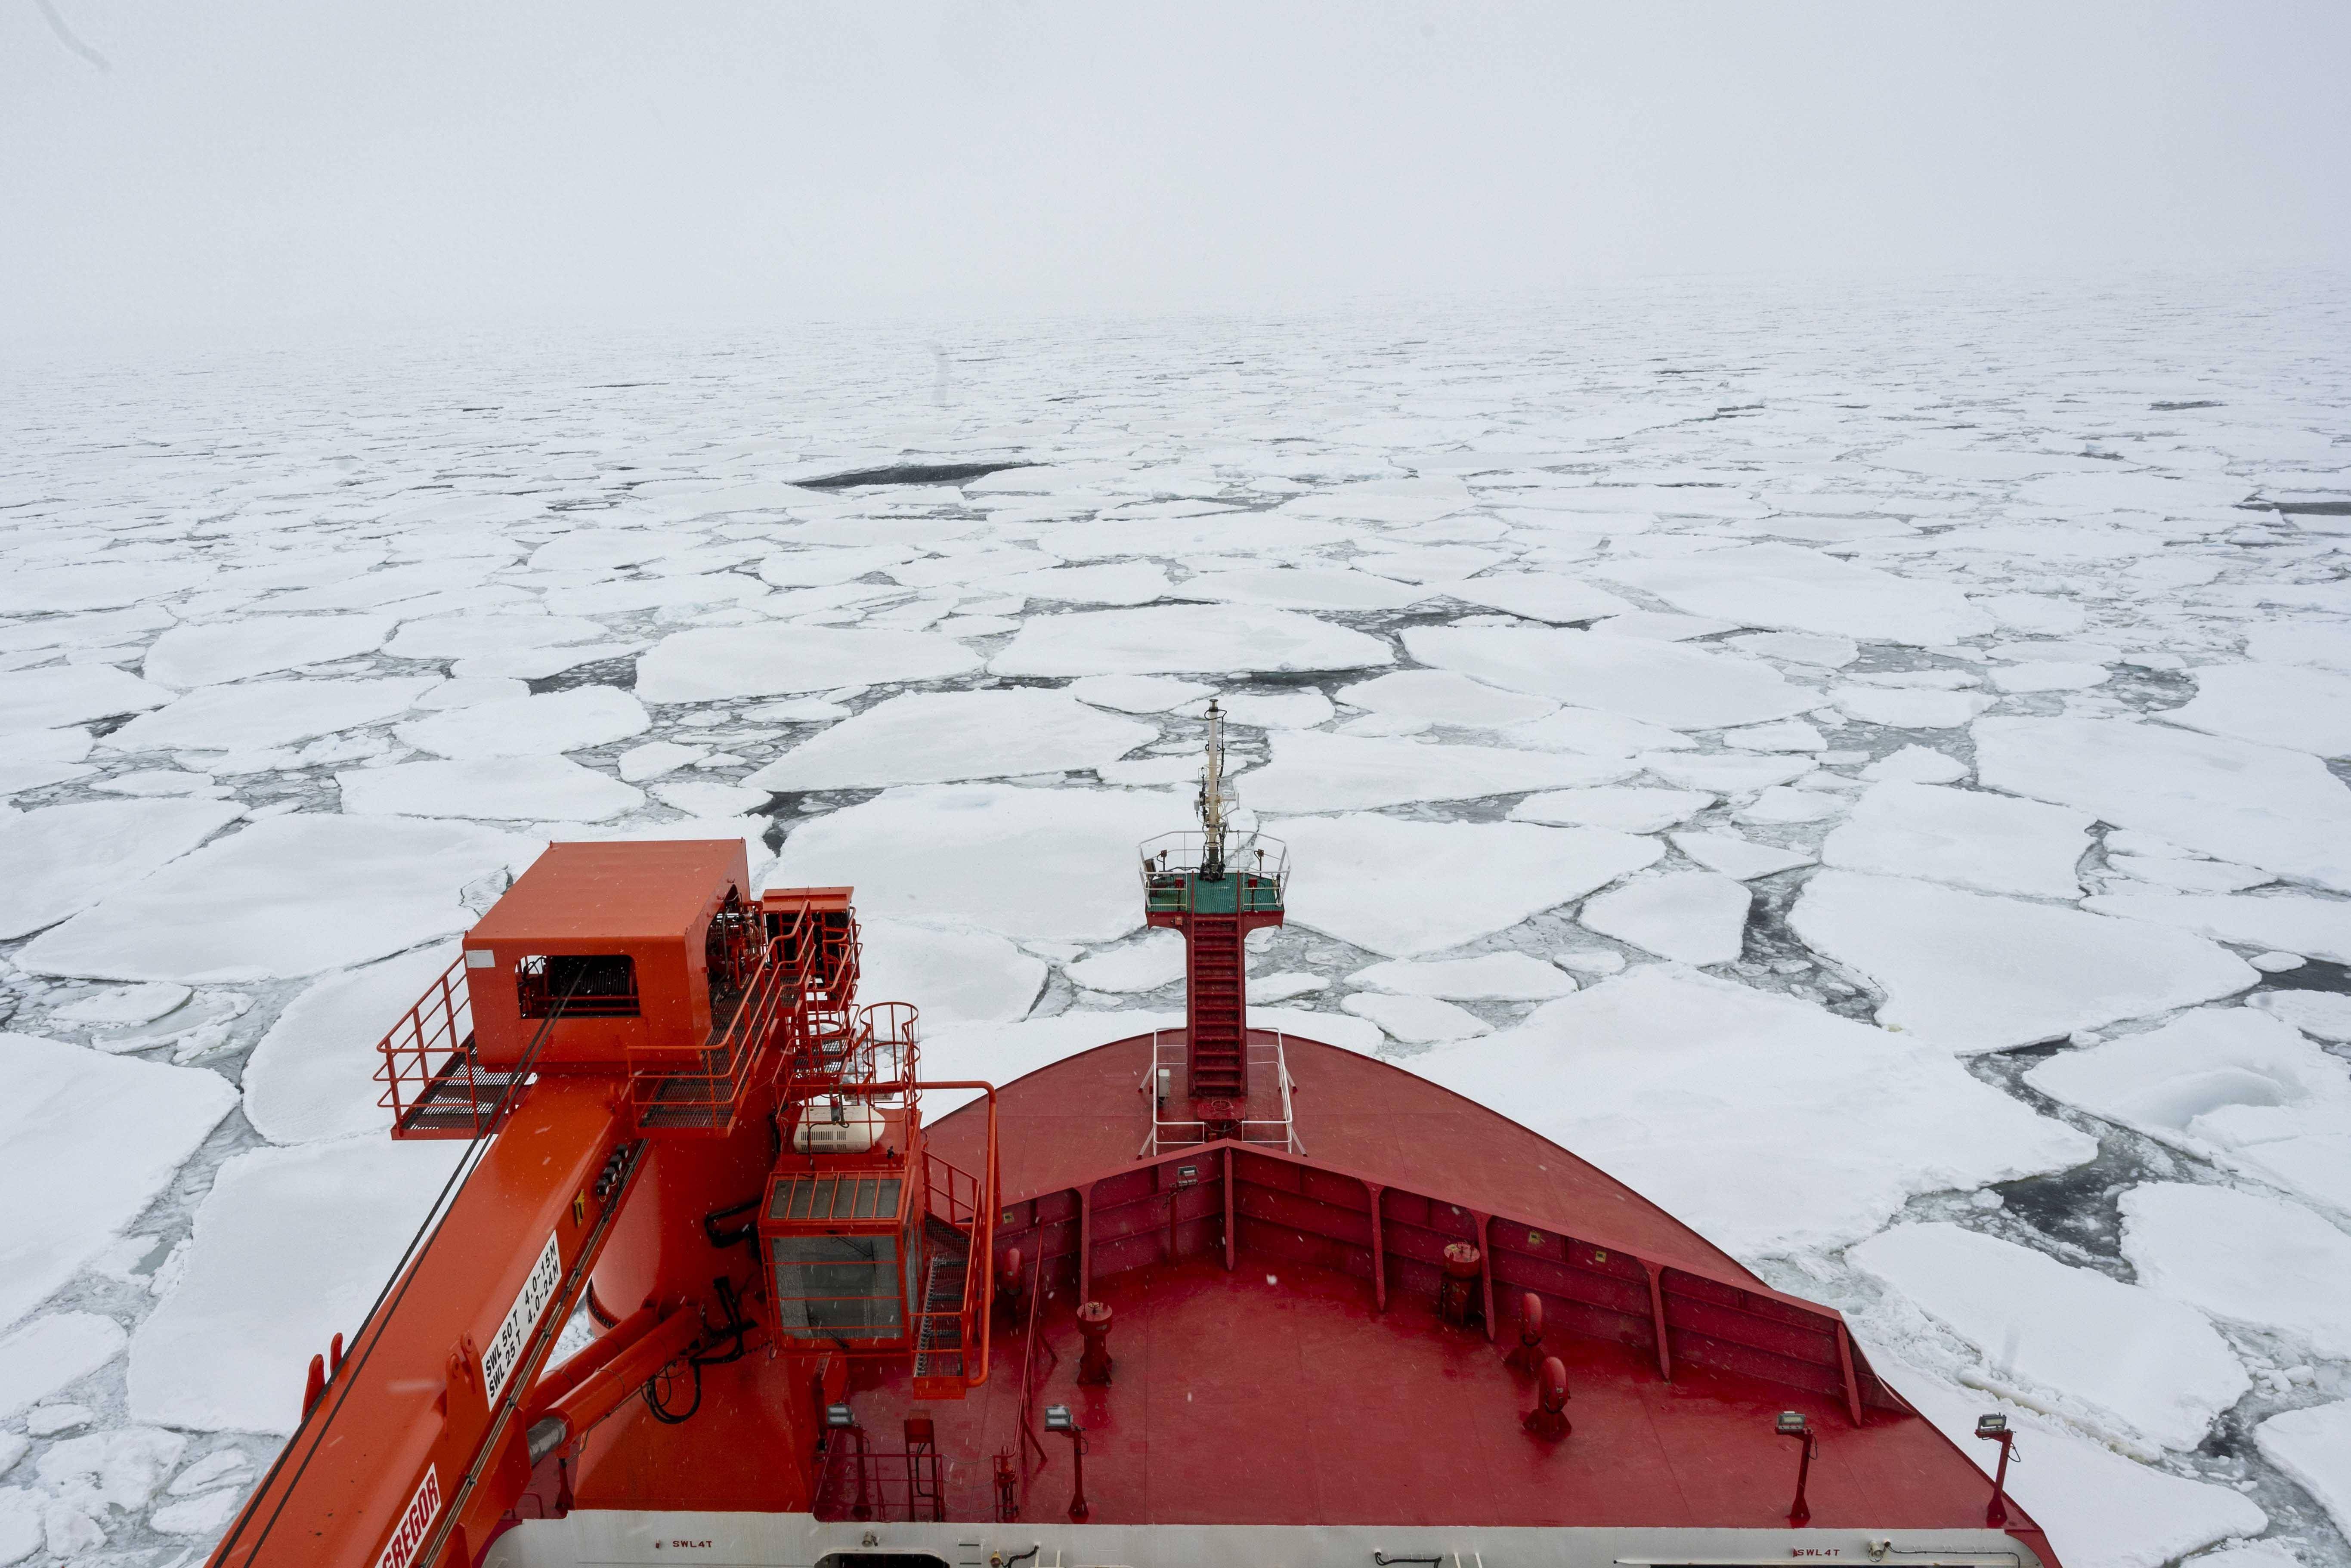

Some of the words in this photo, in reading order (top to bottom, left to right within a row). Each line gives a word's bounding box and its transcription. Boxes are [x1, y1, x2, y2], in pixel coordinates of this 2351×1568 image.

[486, 1344, 501, 1378] SWL
[525, 1240, 556, 1305] 4.0-15M
[489, 1364, 505, 1398] SWL
[528, 1259, 559, 1325] 4.0-24M
